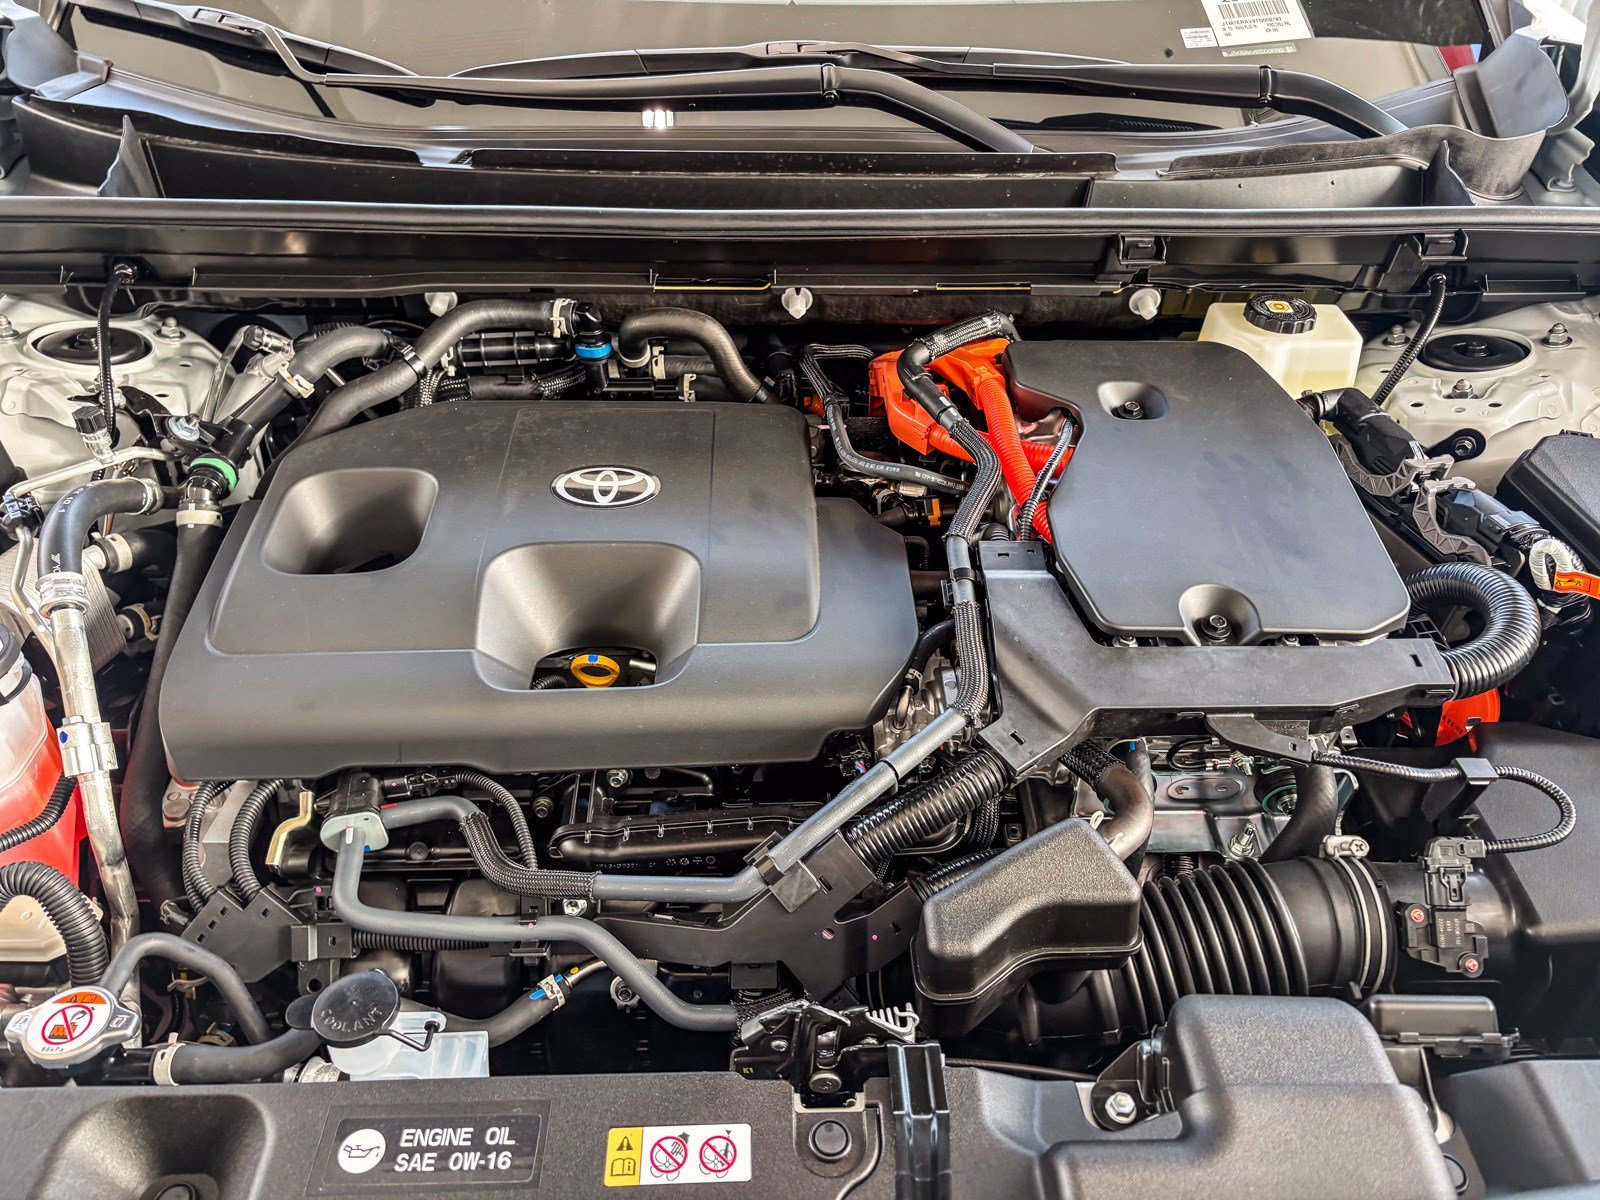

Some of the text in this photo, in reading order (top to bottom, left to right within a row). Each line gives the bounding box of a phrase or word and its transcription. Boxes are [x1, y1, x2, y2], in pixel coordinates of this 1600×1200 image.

[320, 1007, 383, 1033] COOLANT
[400, 1127, 516, 1147] ENGINE OIL
[394, 1151, 512, 1172] SAE 0W-16
